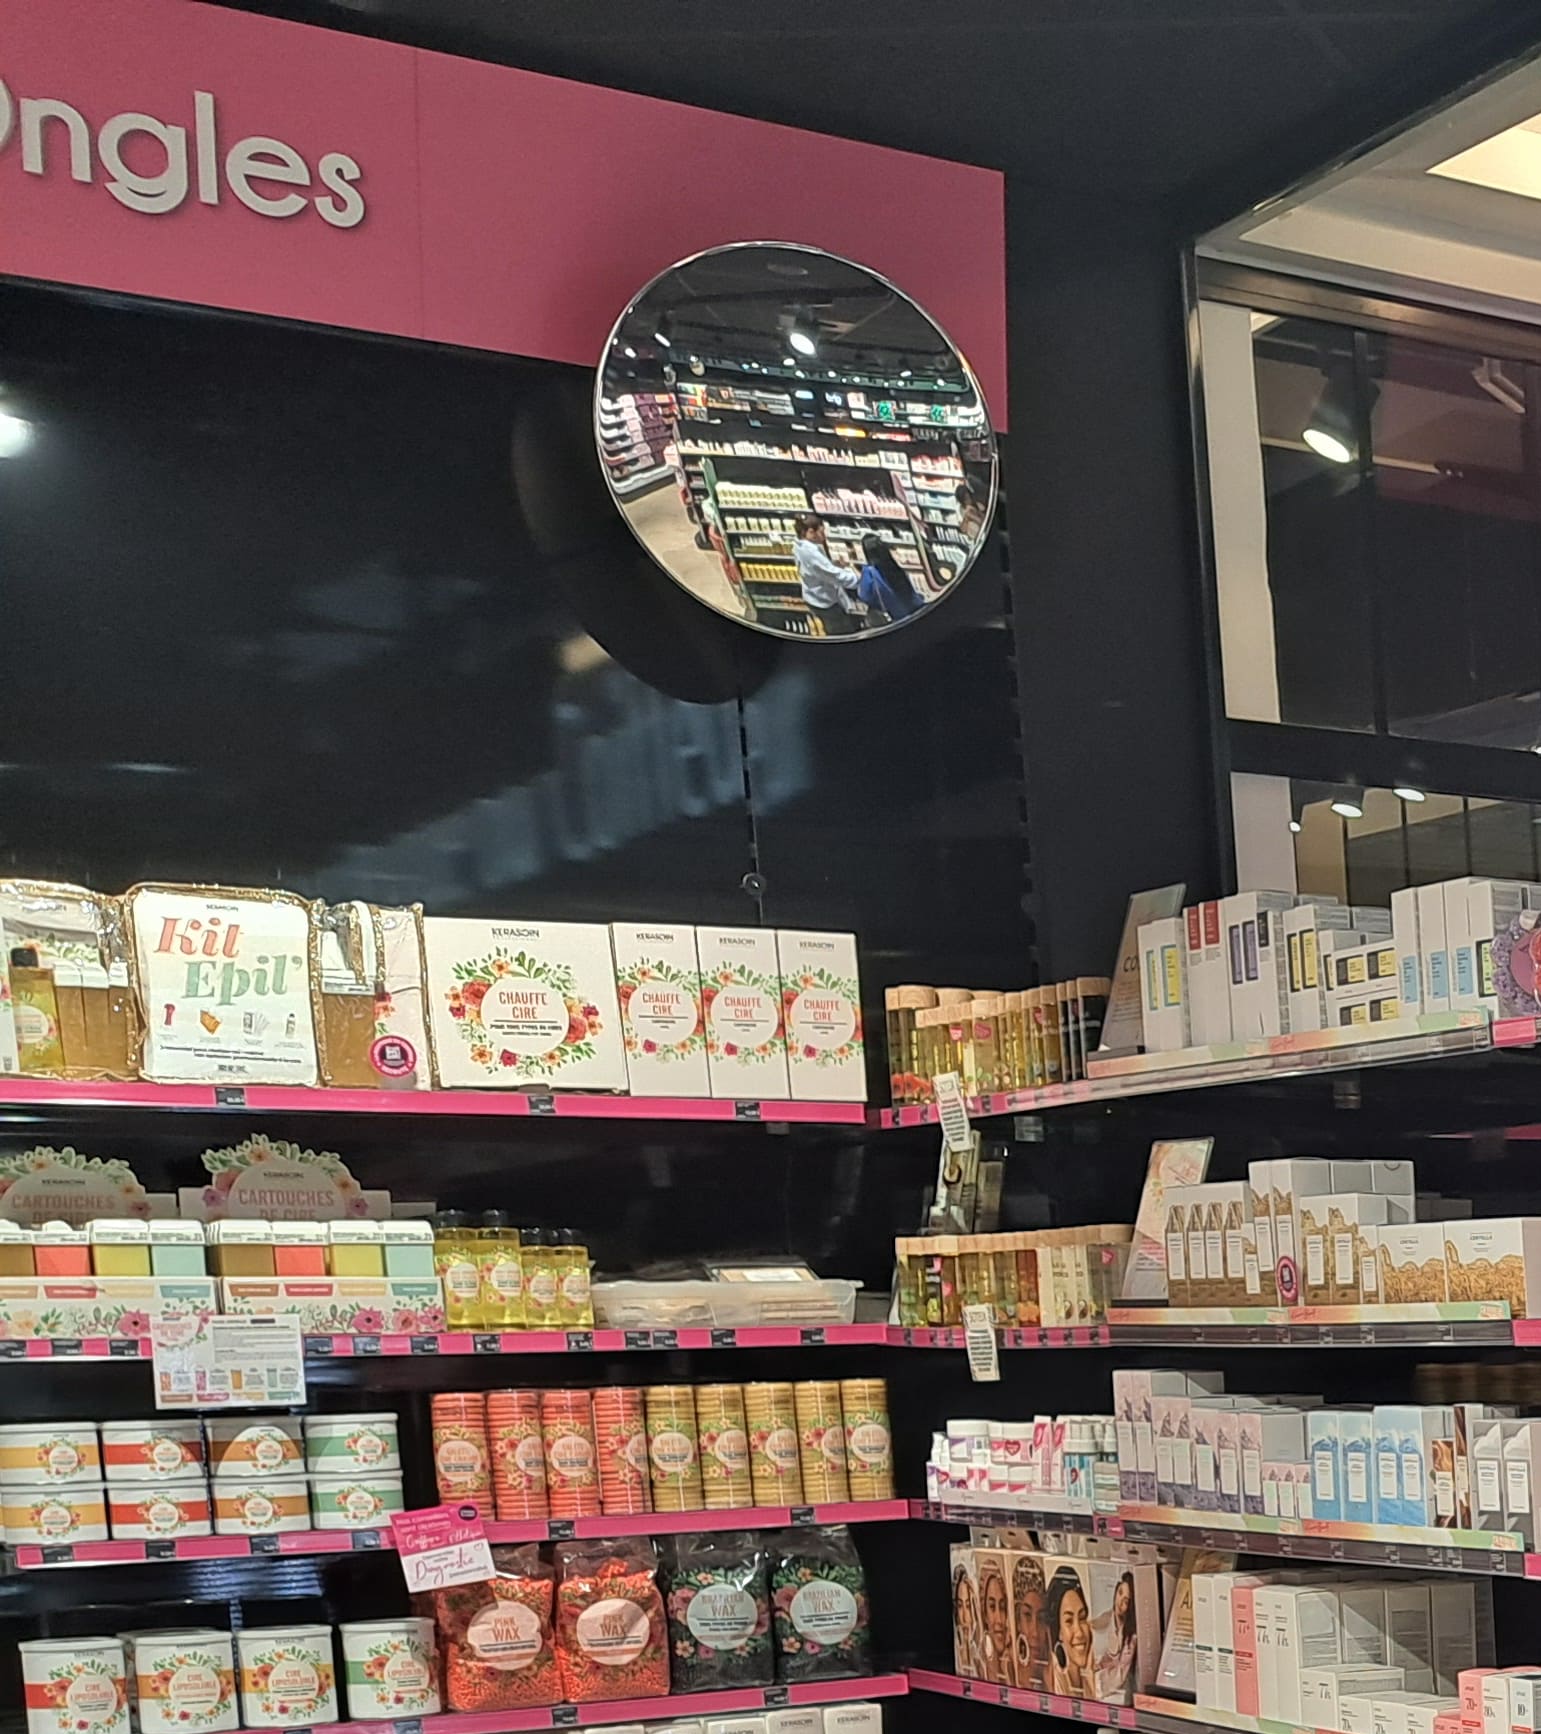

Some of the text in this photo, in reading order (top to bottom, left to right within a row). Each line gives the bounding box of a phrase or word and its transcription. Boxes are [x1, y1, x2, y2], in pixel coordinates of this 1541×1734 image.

[0, 79, 365, 229] ngles
[153, 915, 242, 958] Kit
[499, 991, 548, 1006] CHAUFFE
[642, 992, 682, 1005] CHAUFFE
[724, 996, 762, 1009] CHAUFFE
[652, 1005, 673, 1016] CIRE
[804, 999, 841, 1012] CHAUFFE
[512, 1006, 538, 1020] CIRE
[734, 1008, 754, 1020] CIRE
[813, 1011, 833, 1021] CIRE
[239, 1189, 334, 1207] CARTOUCHES
[711, 1604, 737, 1618] WAX
[811, 1600, 835, 1613] WAX
[492, 1627, 520, 1641] WAX
[600, 1625, 628, 1638] WAX
